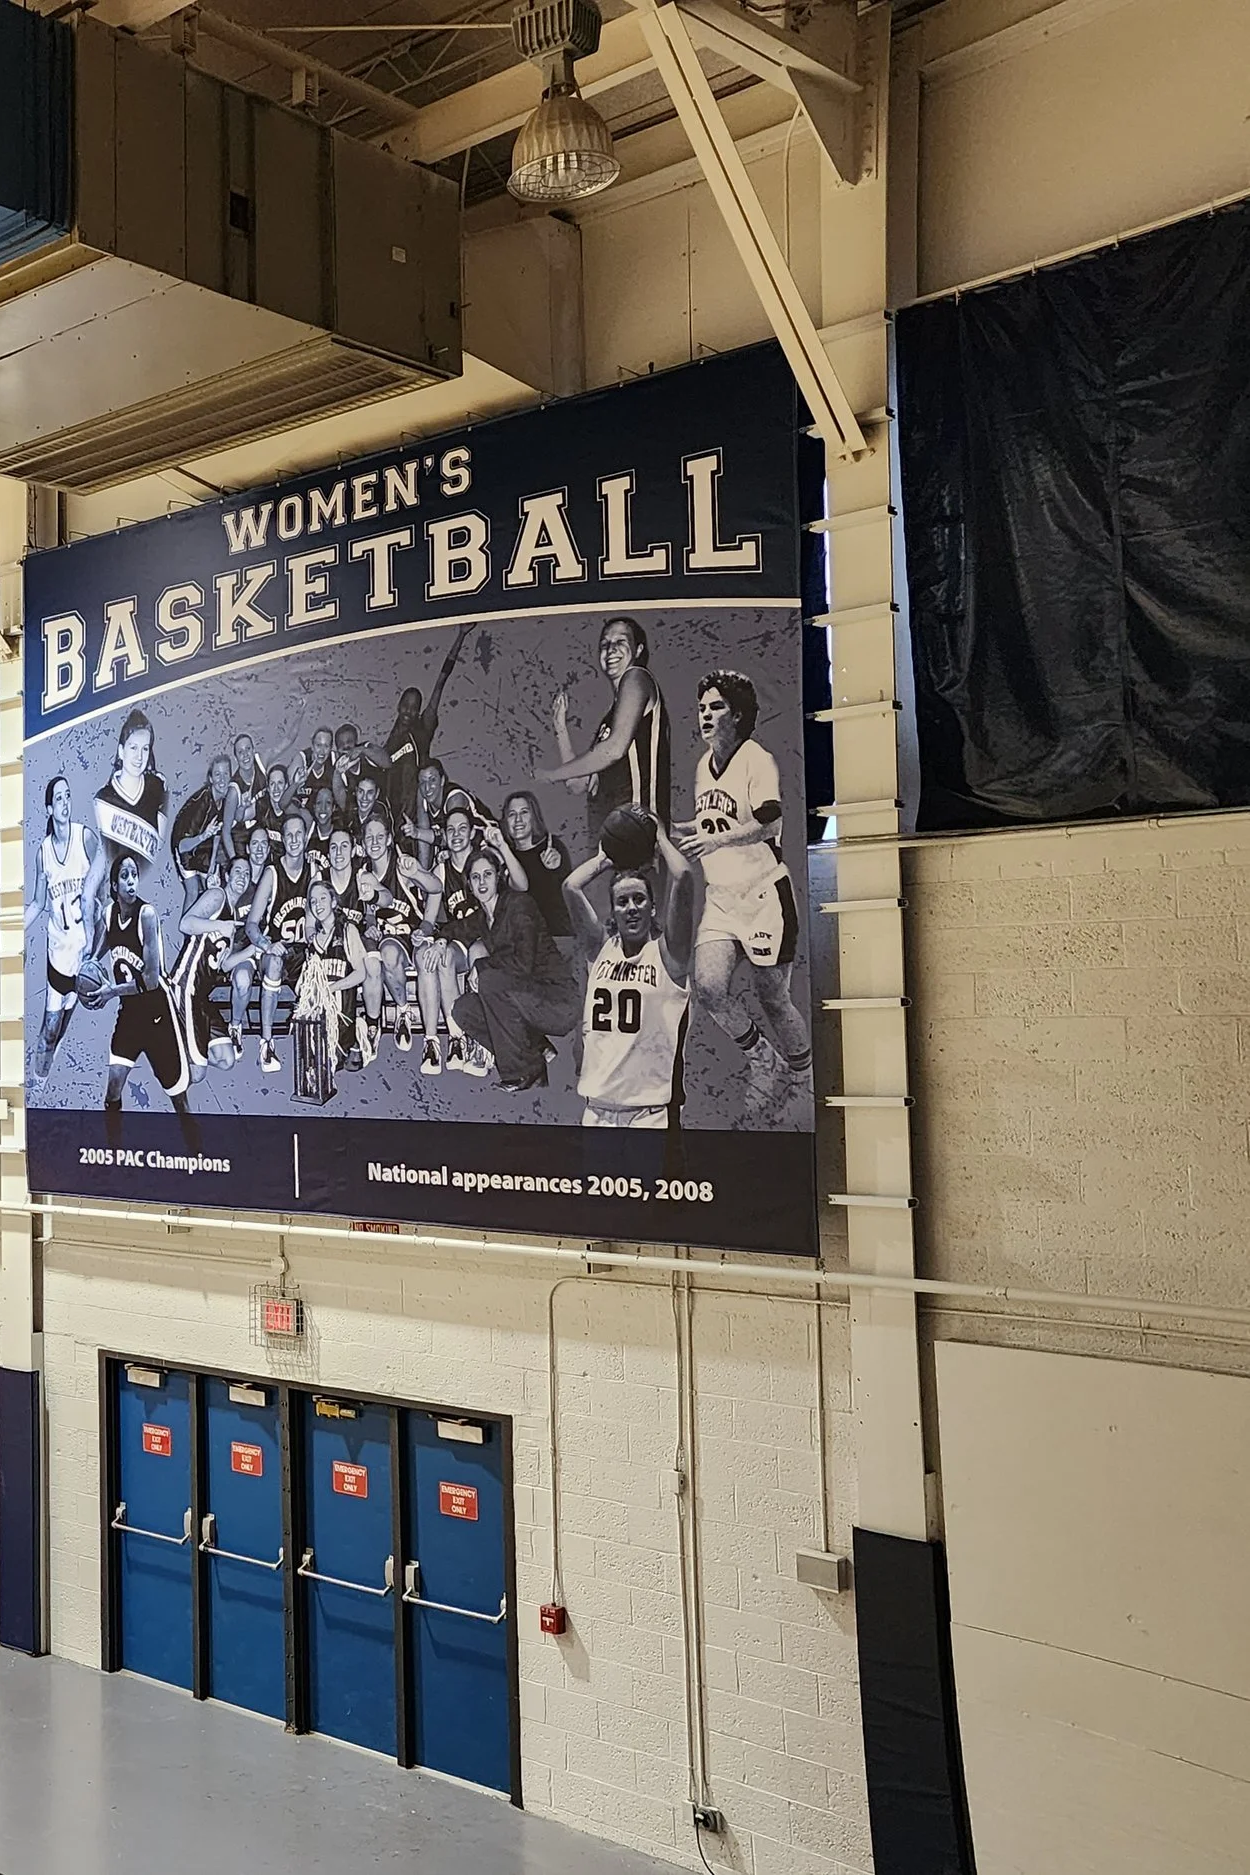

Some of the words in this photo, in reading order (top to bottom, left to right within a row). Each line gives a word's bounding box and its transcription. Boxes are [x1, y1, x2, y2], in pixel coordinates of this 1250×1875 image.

[221, 446, 472, 555] WOMEN'S
[40, 447, 763, 715] BASKETBALL
[592, 987, 641, 1033] 20
[79, 1148, 113, 1166] 2005
[116, 1149, 144, 1168] PAC
[146, 1150, 231, 1175] Champions
[368, 1162, 448, 1186] National
[452, 1171, 583, 1195] appearances
[587, 1175, 649, 1200] 2005,
[655, 1179, 714, 1202] 2008
[365, 1224, 398, 1234] SMOKING
[143, 1425, 169, 1437] EMERGENCY
[232, 1444, 261, 1456] EMERGENCY
[334, 1464, 366, 1477] EMERGENCY
[441, 1485, 476, 1499] EMERGENCY
